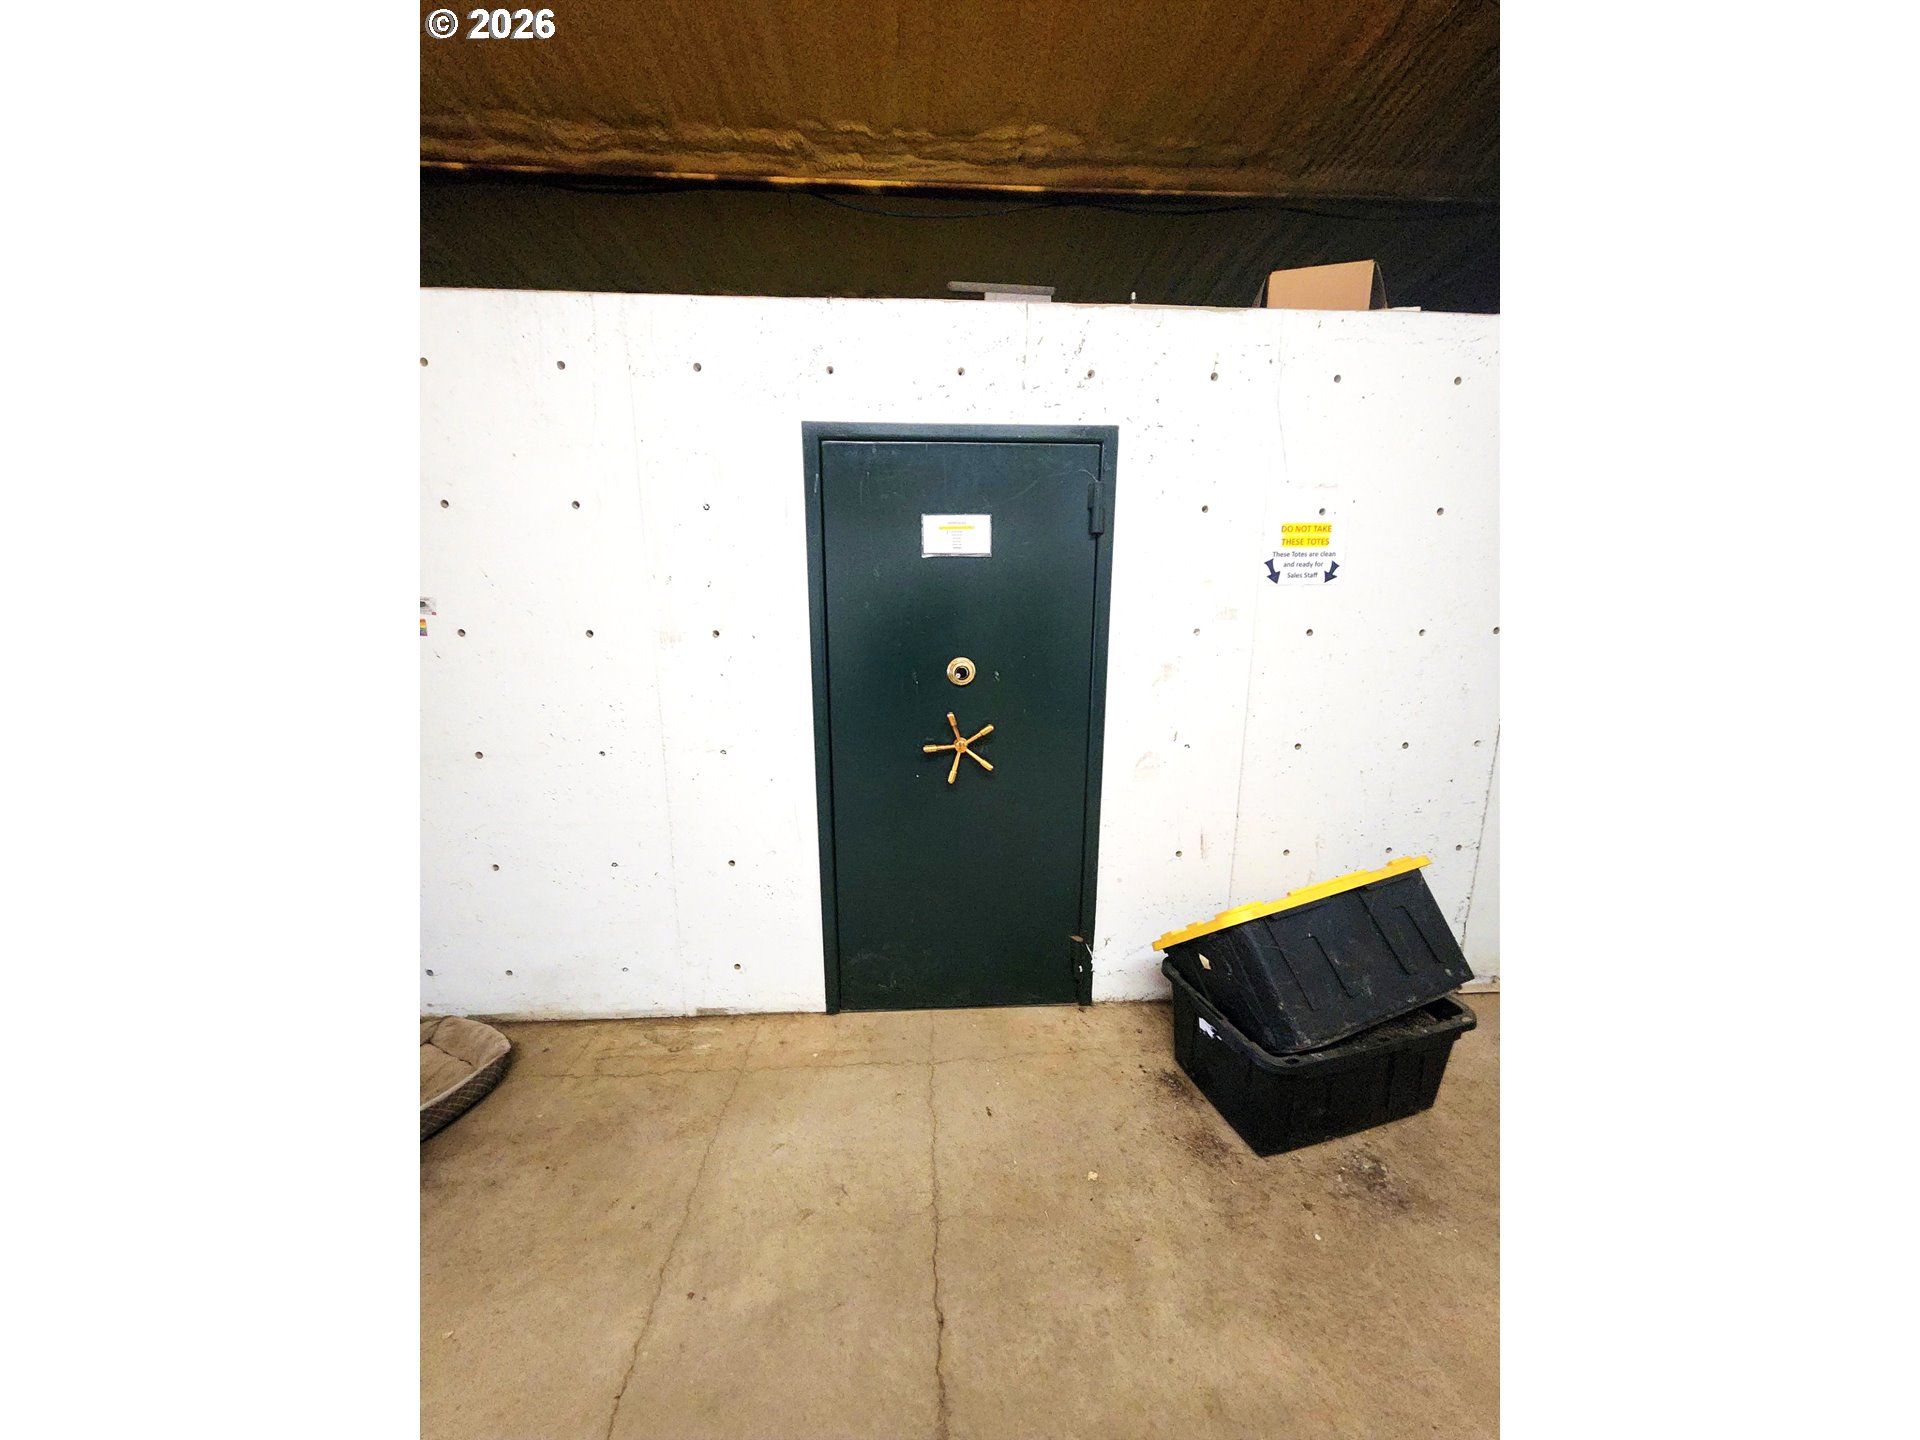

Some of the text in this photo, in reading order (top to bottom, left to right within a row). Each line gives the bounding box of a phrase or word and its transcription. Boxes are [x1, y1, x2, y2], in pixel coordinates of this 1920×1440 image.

[1281, 525, 1332, 533] DO NOT TAKE
[1281, 538, 1330, 546] THESE TOTES
